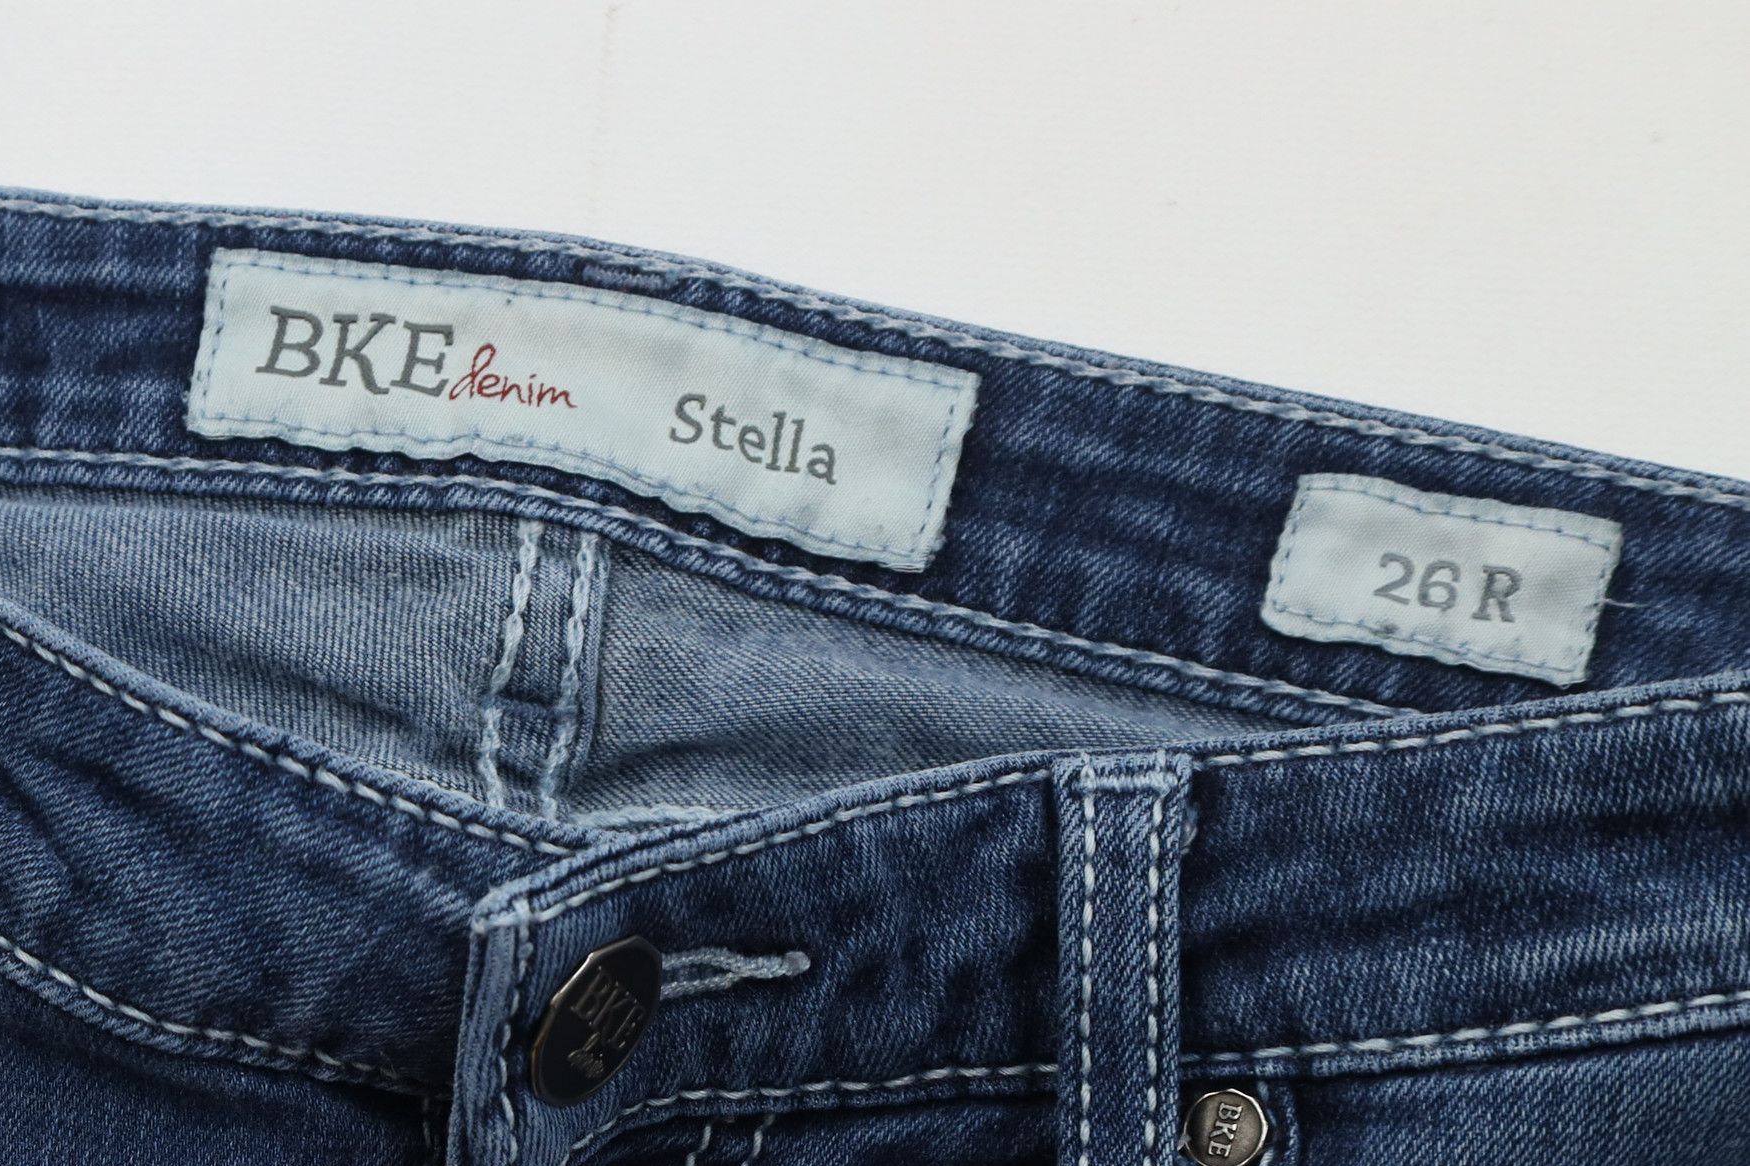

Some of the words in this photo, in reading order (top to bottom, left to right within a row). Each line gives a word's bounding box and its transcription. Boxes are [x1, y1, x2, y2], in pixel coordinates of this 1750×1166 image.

[255, 304, 455, 399] BKE
[449, 343, 578, 410] denim
[668, 394, 838, 486] Stella
[1373, 552, 1462, 612] 26
[1471, 564, 1523, 623] R
[1207, 1102, 1243, 1158] BKE
